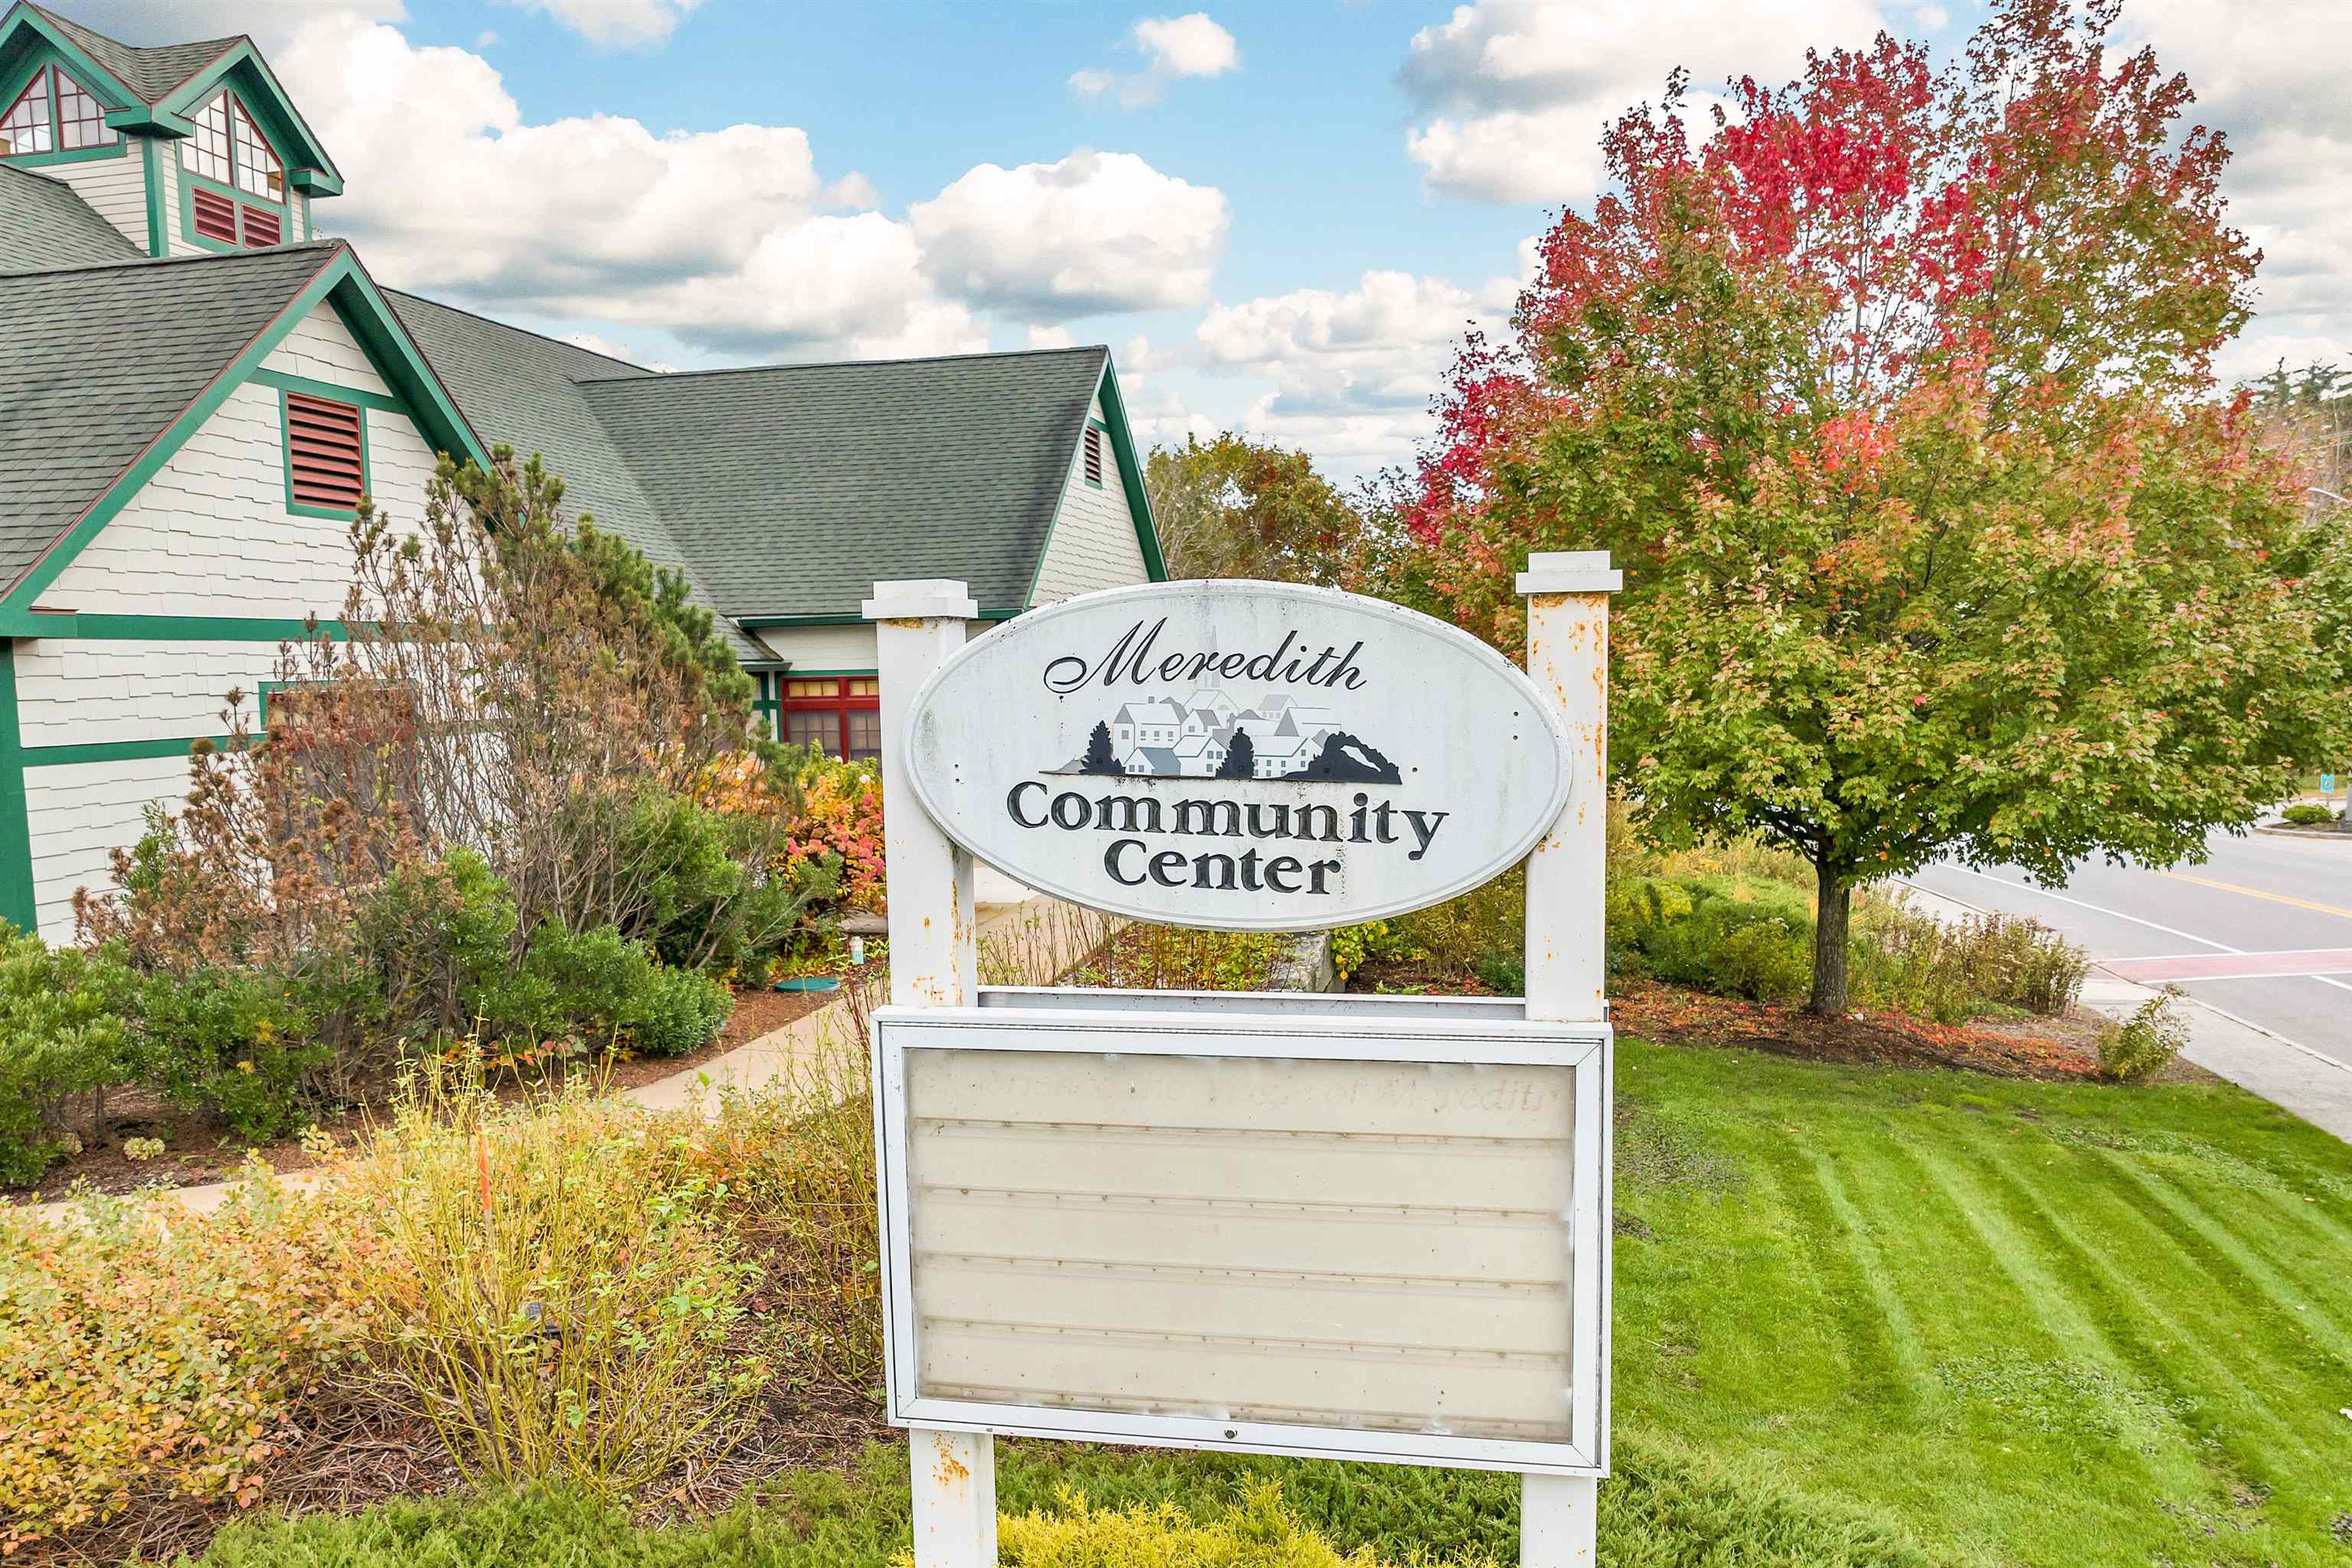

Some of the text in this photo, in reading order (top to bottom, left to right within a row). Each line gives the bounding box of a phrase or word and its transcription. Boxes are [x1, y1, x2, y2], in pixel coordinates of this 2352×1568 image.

[1044, 616, 1367, 694] Meredith
[1007, 780, 1450, 861] Community
[1104, 839, 1342, 895] Center
